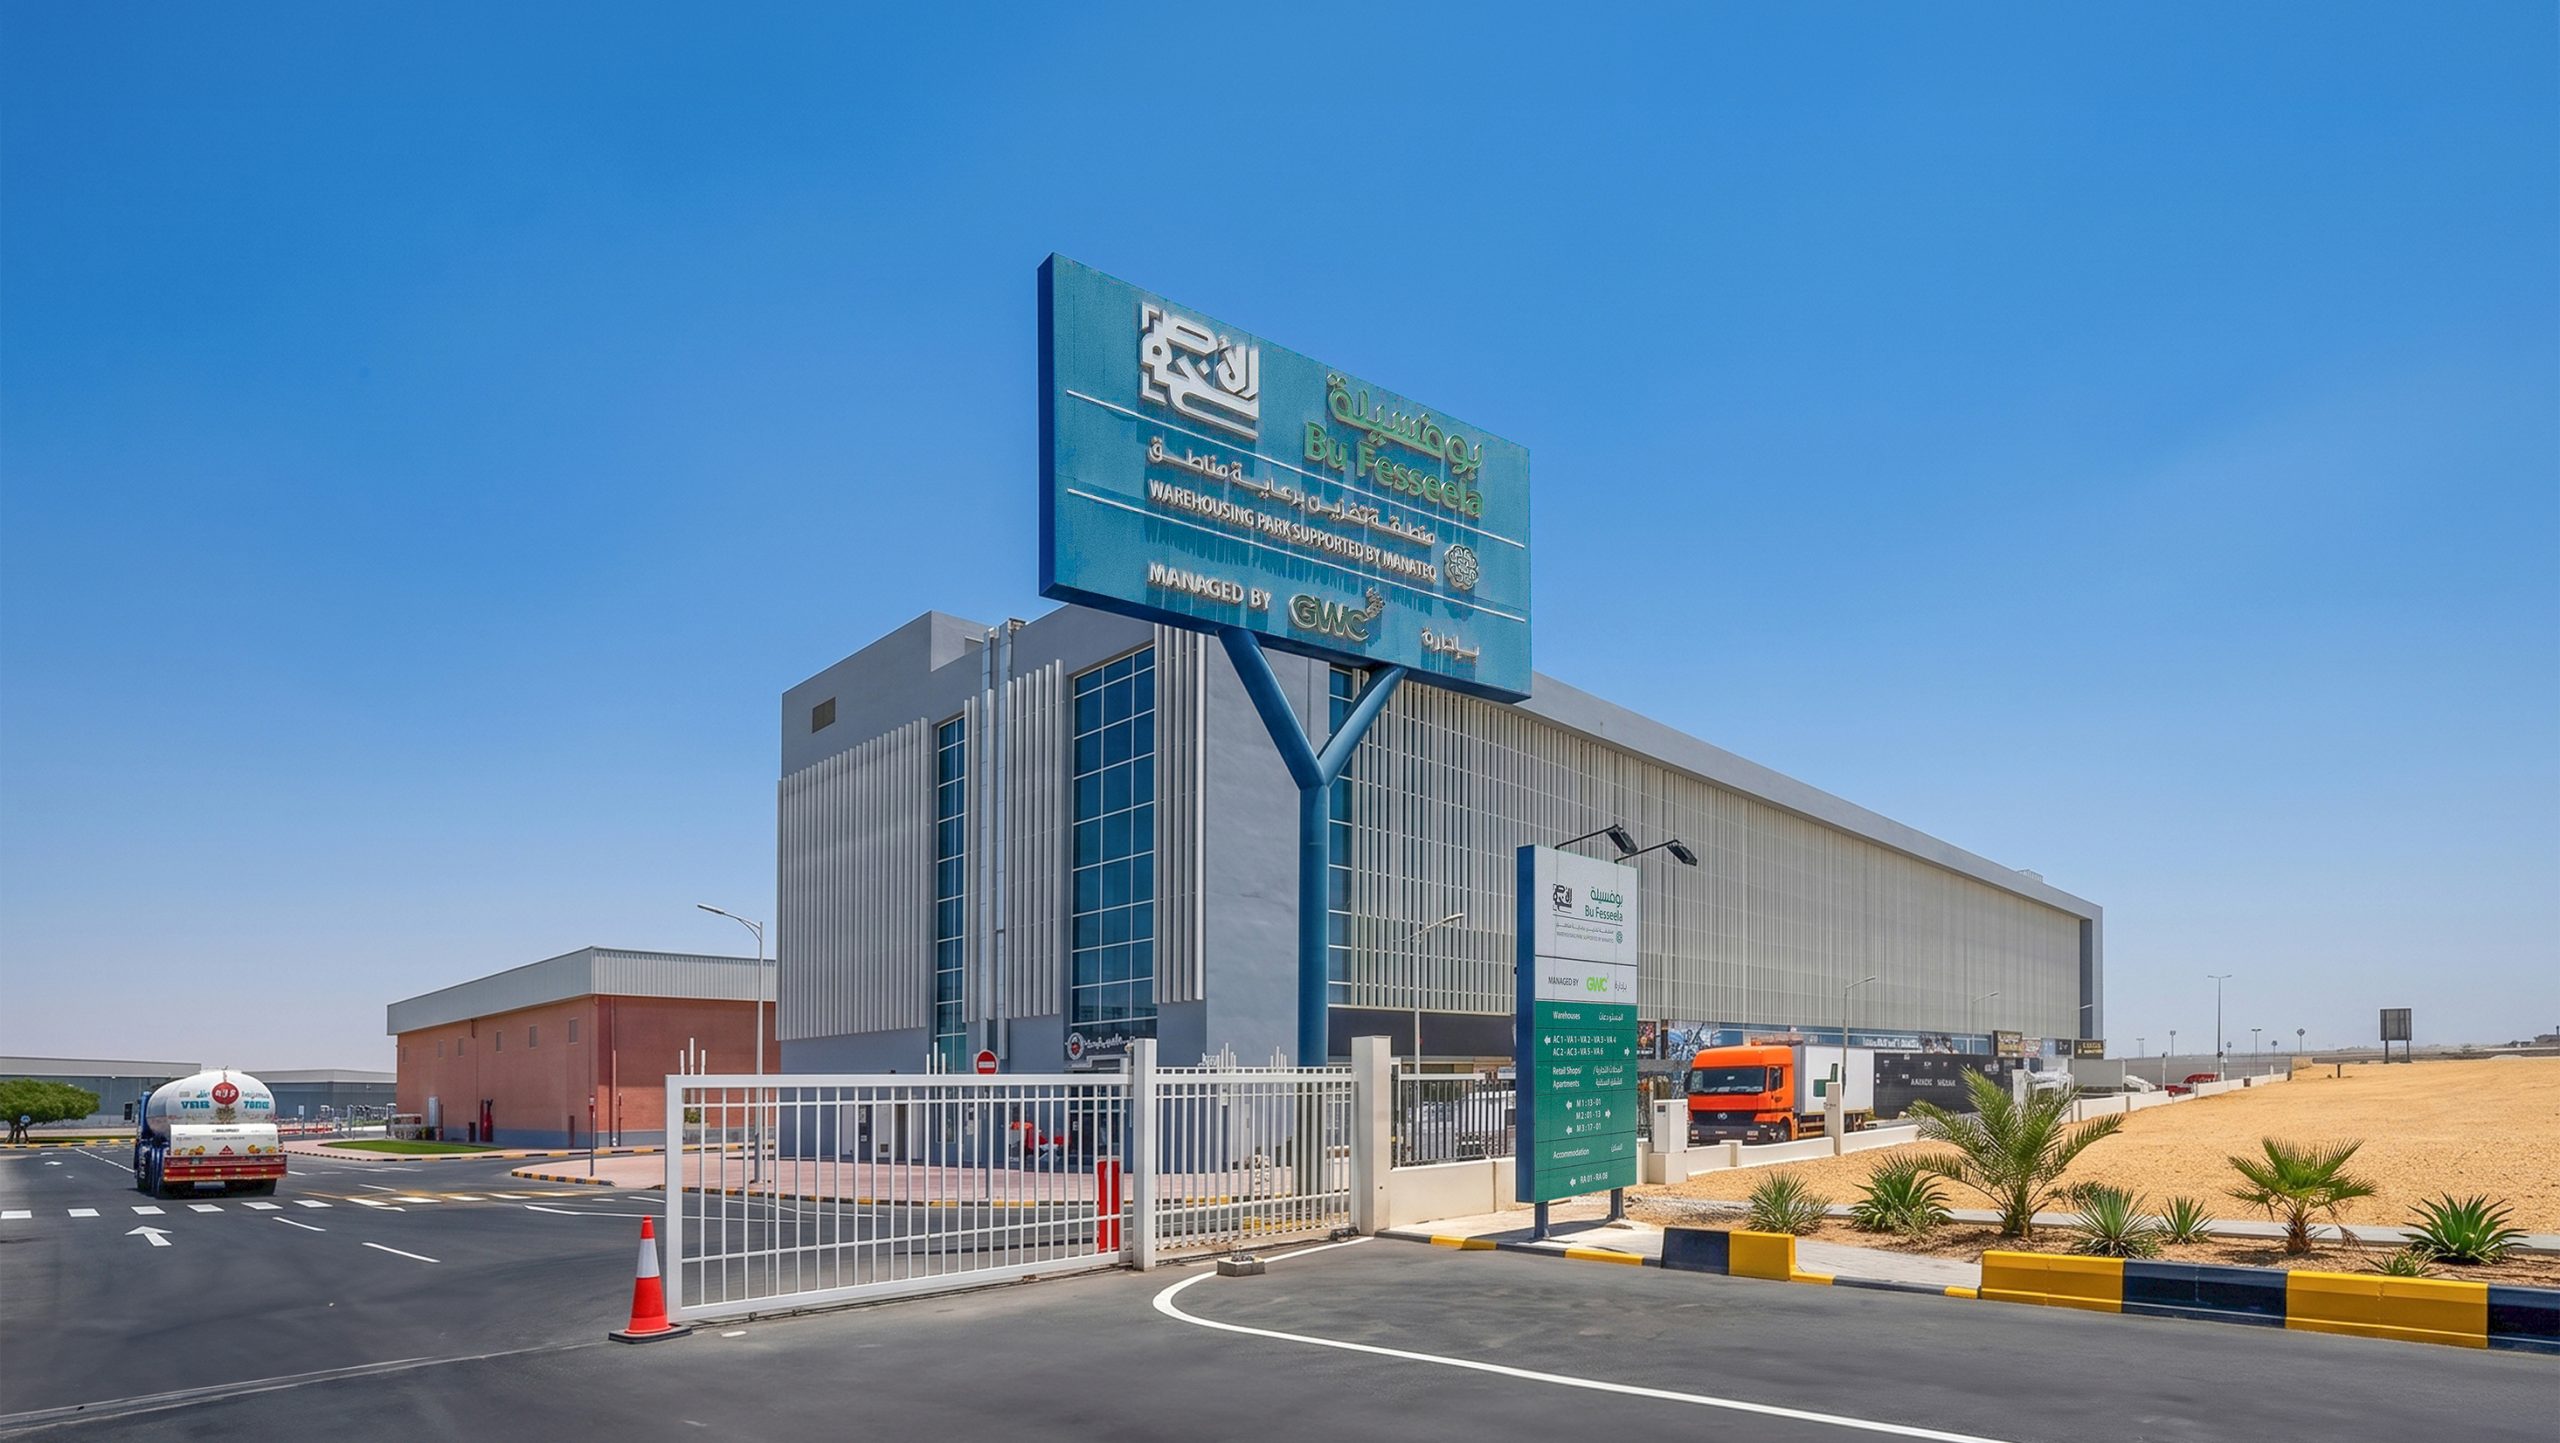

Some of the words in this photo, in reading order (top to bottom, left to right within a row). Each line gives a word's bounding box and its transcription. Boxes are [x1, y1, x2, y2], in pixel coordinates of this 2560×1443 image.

[1327, 374, 1483, 479] بوفسيلة
[1304, 421, 1348, 472] Bu
[1357, 442, 1483, 518] Fesseela
[1148, 479, 1256, 527] WAREHOUSING
[1257, 511, 1291, 539] PARK
[1292, 523, 1365, 560] SUPPORTED
[1366, 545, 1381, 565] BY
[1382, 551, 1437, 582] MANATEQ
[1148, 562, 1245, 603] MANAGED
[1250, 586, 1272, 610] BY
[1288, 594, 1370, 641] GWC
[1584, 904, 1595, 917] Bu
[1595, 907, 1624, 922] Fesseela
[1548, 976, 1572, 987] MANAGED
[1572, 978, 1579, 987] BY
[1586, 976, 1608, 993] GWC
[1553, 1011, 1581, 1021] Warehouses
[1552, 1066, 1566, 1075] Retail
[1552, 1080, 1580, 1090] Apartments
[1552, 1147, 1590, 1159] Accommodation
